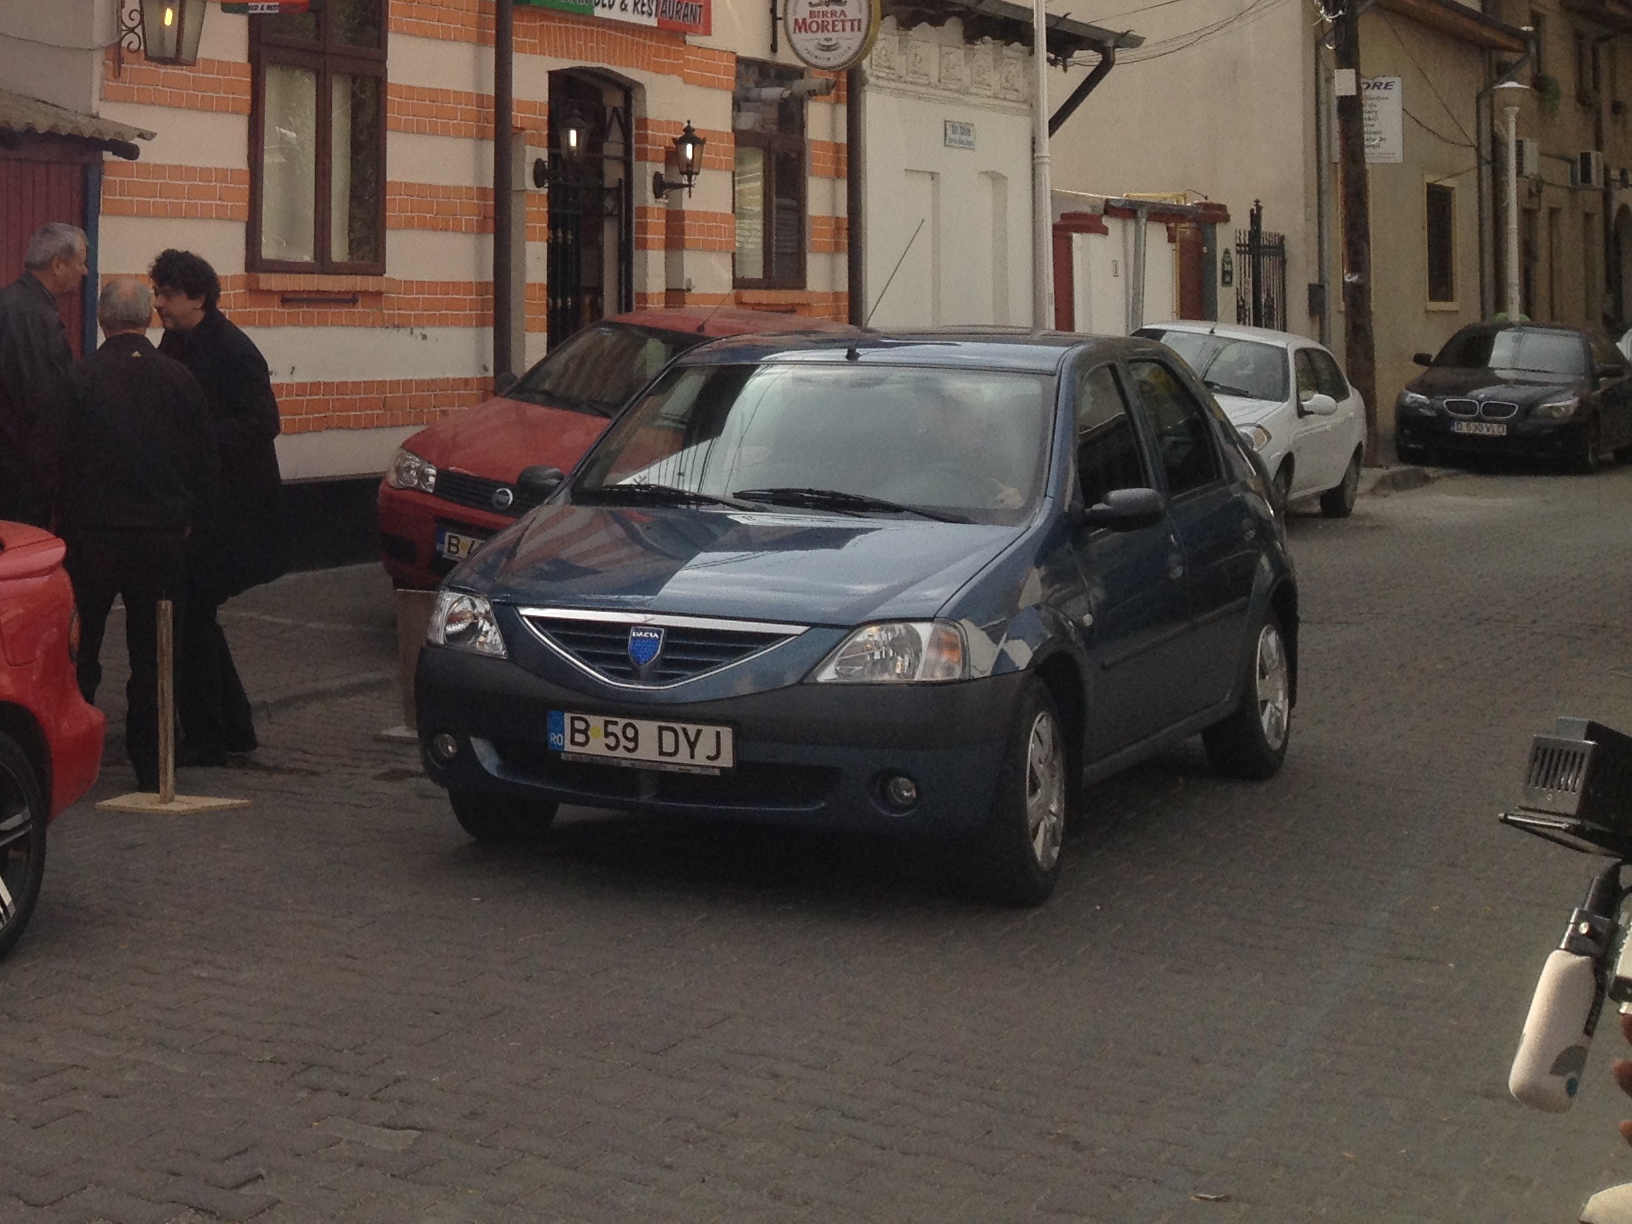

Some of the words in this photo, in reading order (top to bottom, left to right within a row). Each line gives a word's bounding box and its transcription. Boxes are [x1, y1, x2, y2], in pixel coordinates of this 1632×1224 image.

[808, 9, 848, 19] BIRRA
[793, 17, 862, 34] MORETTI
[447, 534, 461, 555] B
[632, 631, 659, 639] DACIA
[570, 715, 591, 748] B
[604, 719, 639, 754] 59
[658, 725, 722, 762] DYJ
